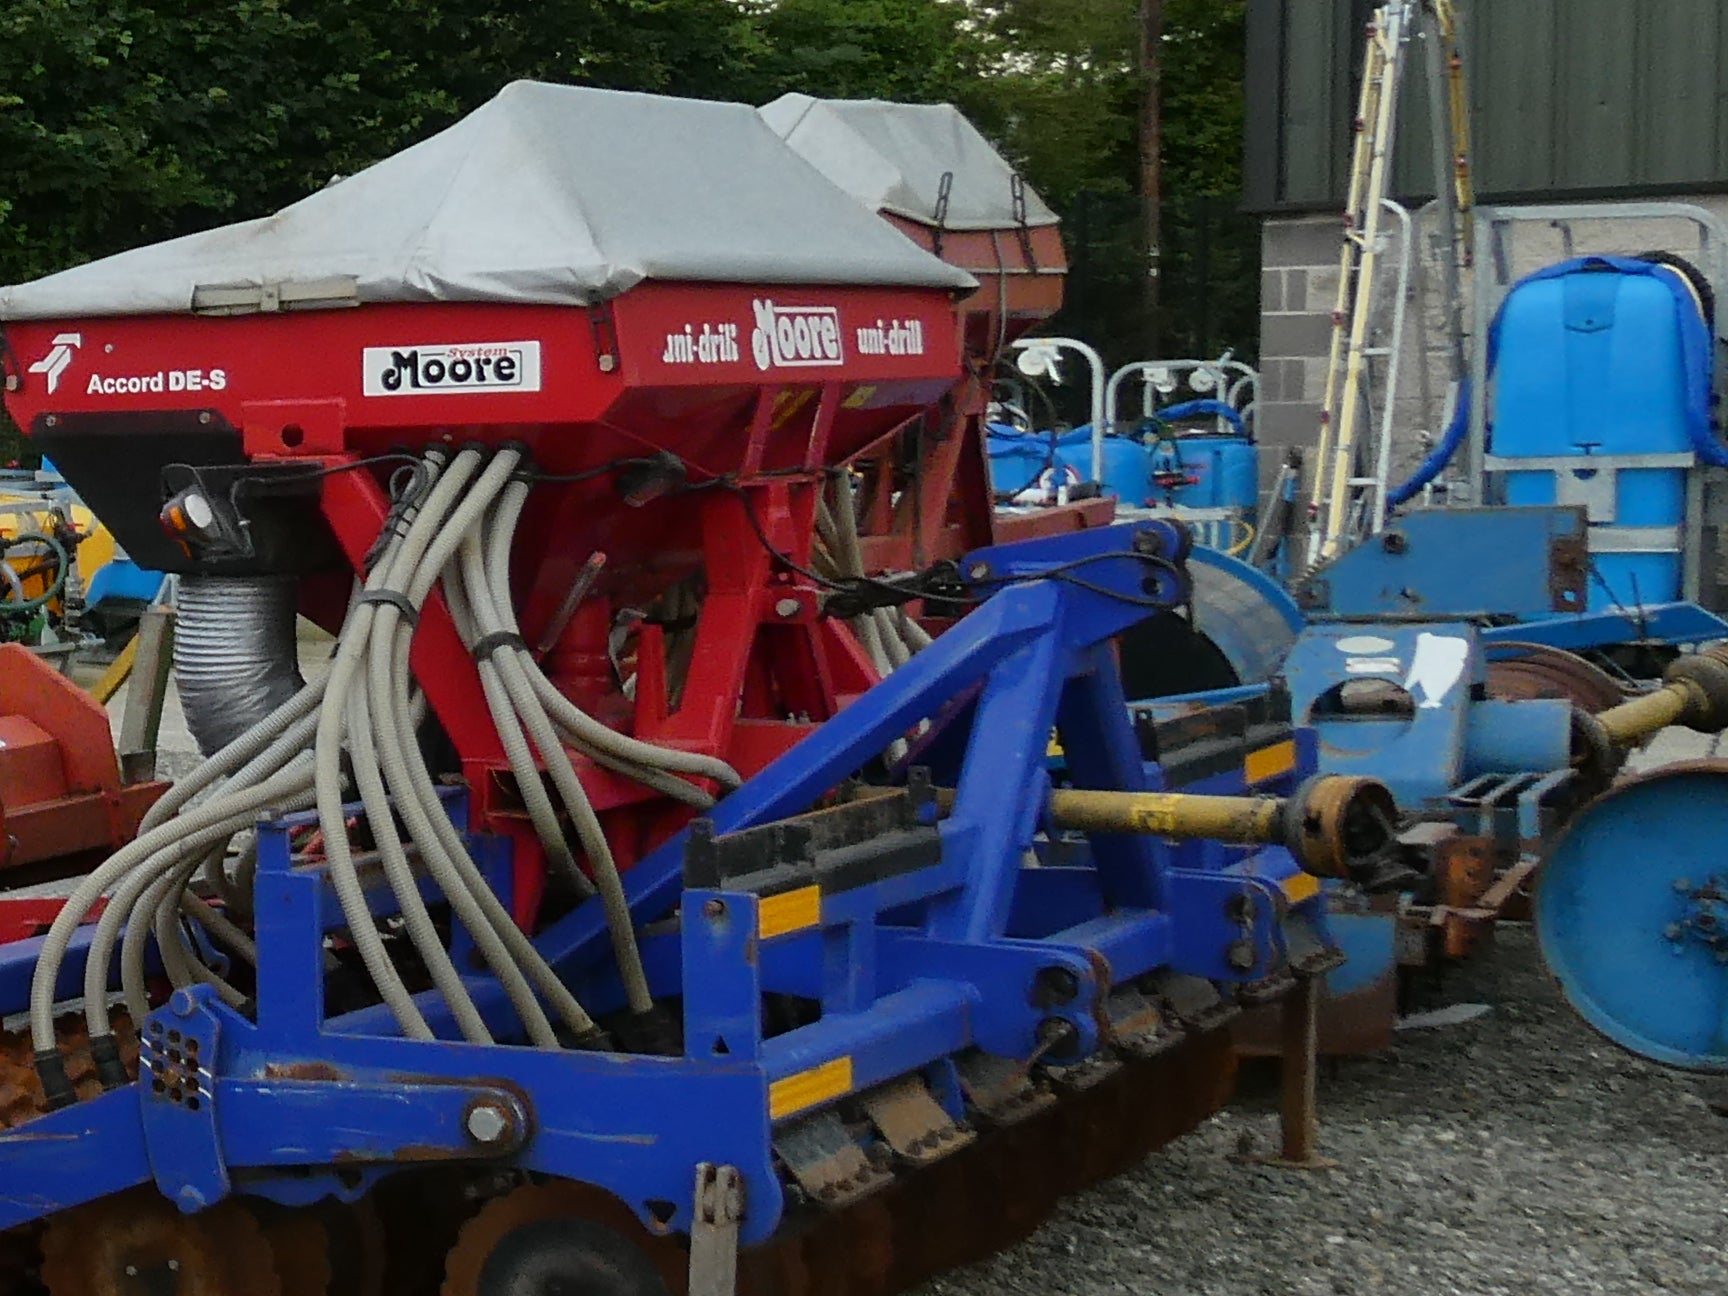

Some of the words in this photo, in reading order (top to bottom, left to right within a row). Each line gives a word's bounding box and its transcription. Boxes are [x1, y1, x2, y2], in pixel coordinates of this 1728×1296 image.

[752, 298, 841, 371] Moore
[857, 318, 923, 354] uni-drill
[447, 347, 509, 360] System
[86, 371, 164, 394] Accord
[168, 369, 227, 391] DE-S
[381, 350, 516, 391] Moore
